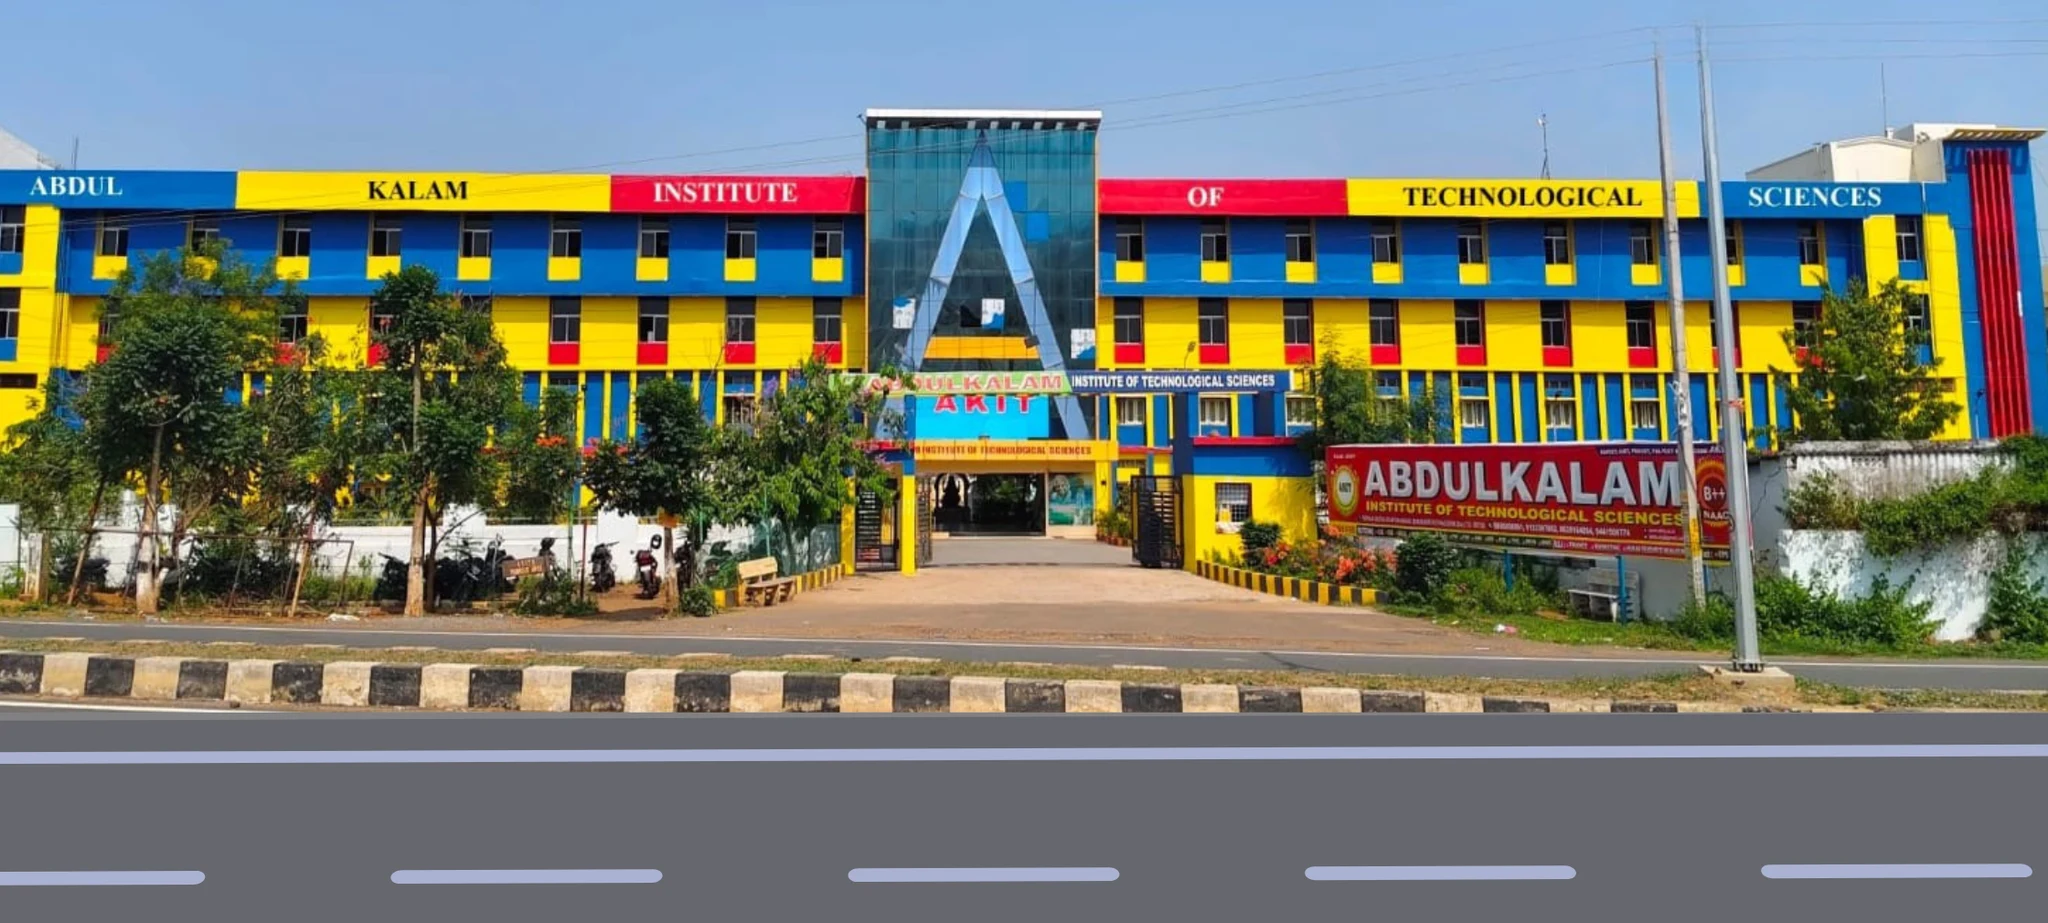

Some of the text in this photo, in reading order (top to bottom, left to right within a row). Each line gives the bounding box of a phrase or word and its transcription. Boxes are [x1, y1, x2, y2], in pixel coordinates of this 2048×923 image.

[30, 176, 1883, 208] ABDUL KALAM INSTITUTE OF TECHNOLOGICAL SCIENCES
[1071, 375, 1123, 387] INSTITUTE
[1126, 375, 1139, 387] OF
[1142, 375, 1224, 388] TECHNOLOGICAL
[1226, 374, 1275, 387] SCIENCES
[934, 395, 1036, 413] AKIT
[1049, 446, 1092, 455] SCIENCES
[1364, 460, 1682, 507] ABDULKALAM
[1703, 486, 1725, 501] B++
[1366, 501, 1432, 514] INSTITUTE
[1436, 504, 1453, 515] OF
[1458, 505, 1588, 522] TECHNOLOGICAL
[1593, 511, 1683, 526] SCIENCES
[1703, 510, 1728, 520] NAAC
